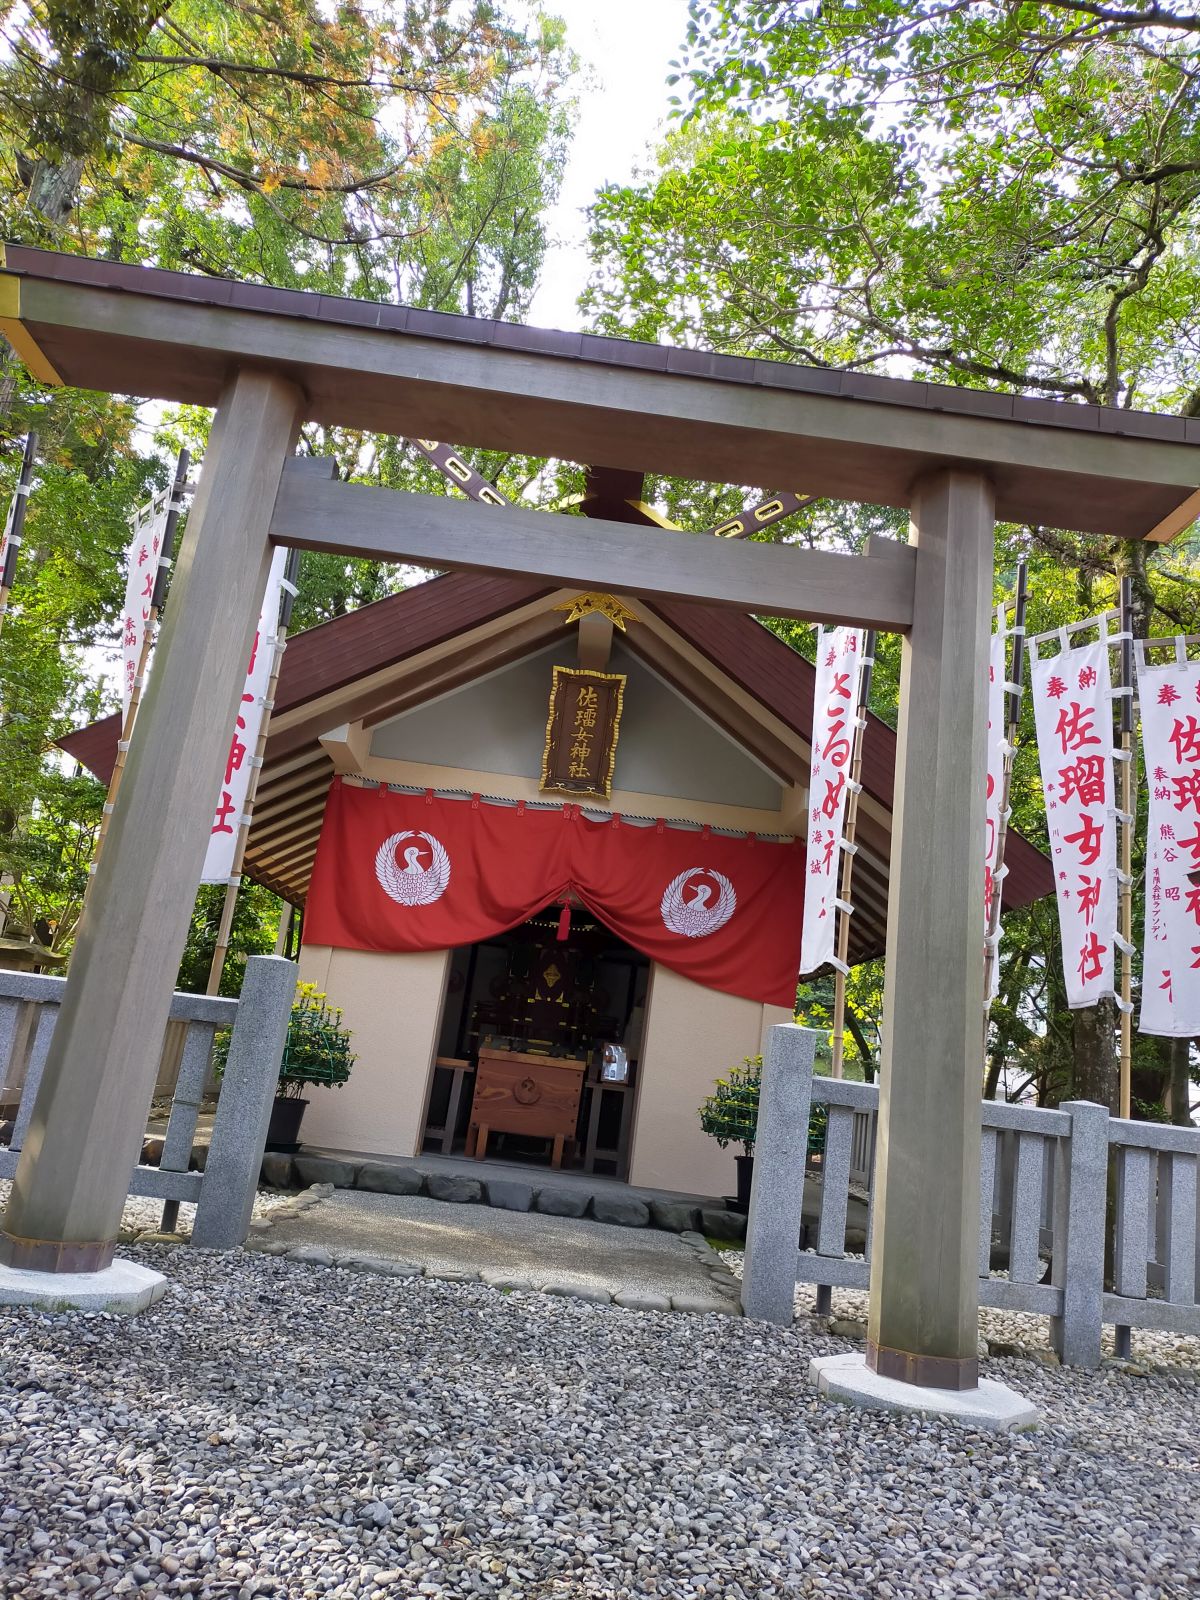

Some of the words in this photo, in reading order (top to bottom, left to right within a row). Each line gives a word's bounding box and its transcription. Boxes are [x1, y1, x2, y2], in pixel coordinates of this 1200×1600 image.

[124, 616, 137, 647] 奉納
[1046, 665, 1097, 700] 奉納
[1153, 765, 1171, 801] 奉納
[1054, 701, 1108, 988] 佐瑠女神社
